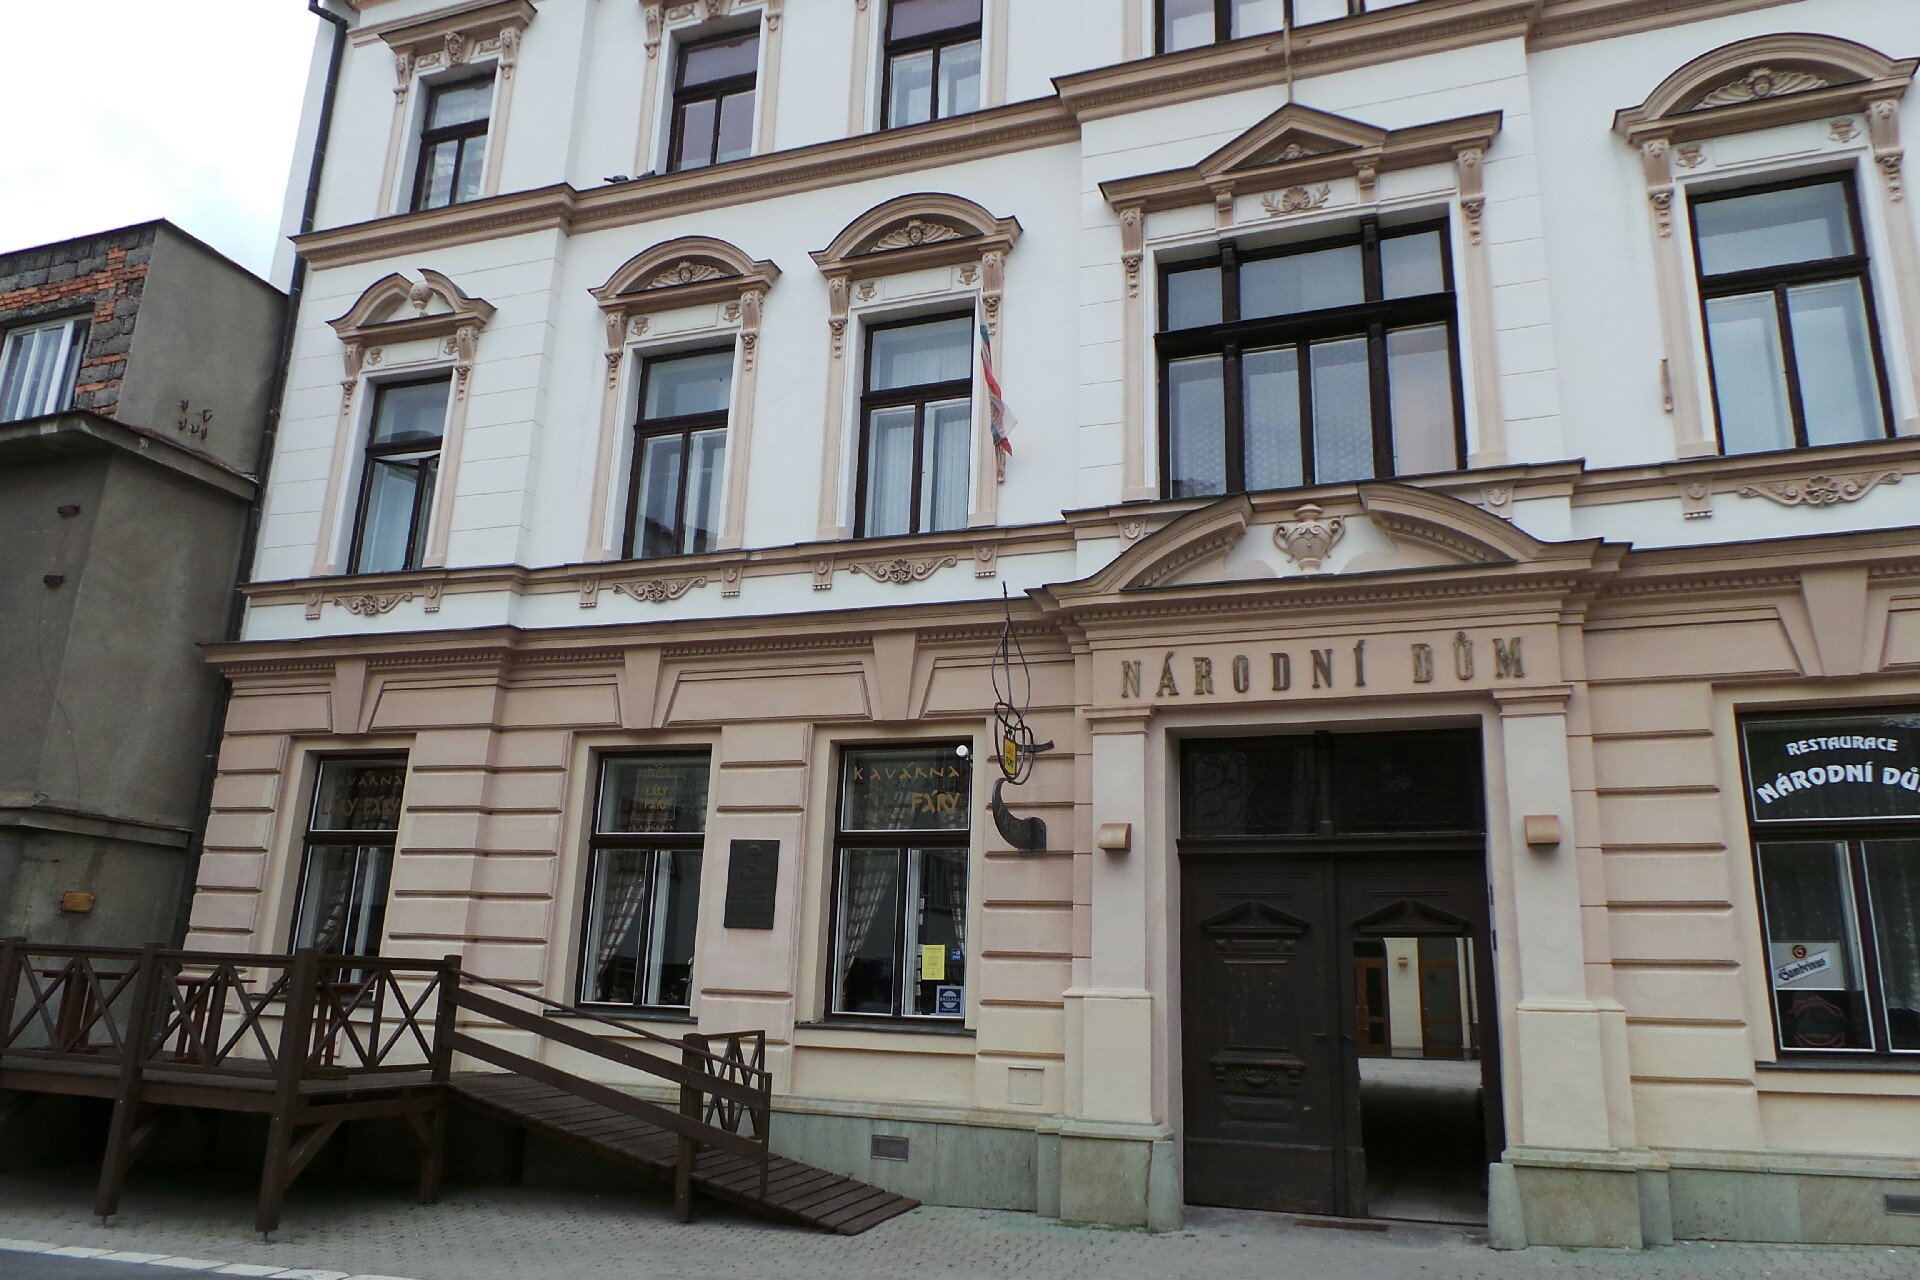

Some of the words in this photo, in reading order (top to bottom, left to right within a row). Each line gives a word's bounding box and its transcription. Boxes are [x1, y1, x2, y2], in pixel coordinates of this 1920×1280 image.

[1121, 639, 1367, 698] NÁRODNÍ
[1410, 631, 1526, 684] DŮM
[1786, 735, 1899, 756] RESTAURACE
[854, 762, 960, 781] KAVÁRNA
[1756, 761, 1873, 804] NÁRODNÍ
[1882, 766, 1920, 793] DŮ
[911, 789, 961, 815] FÁRY
